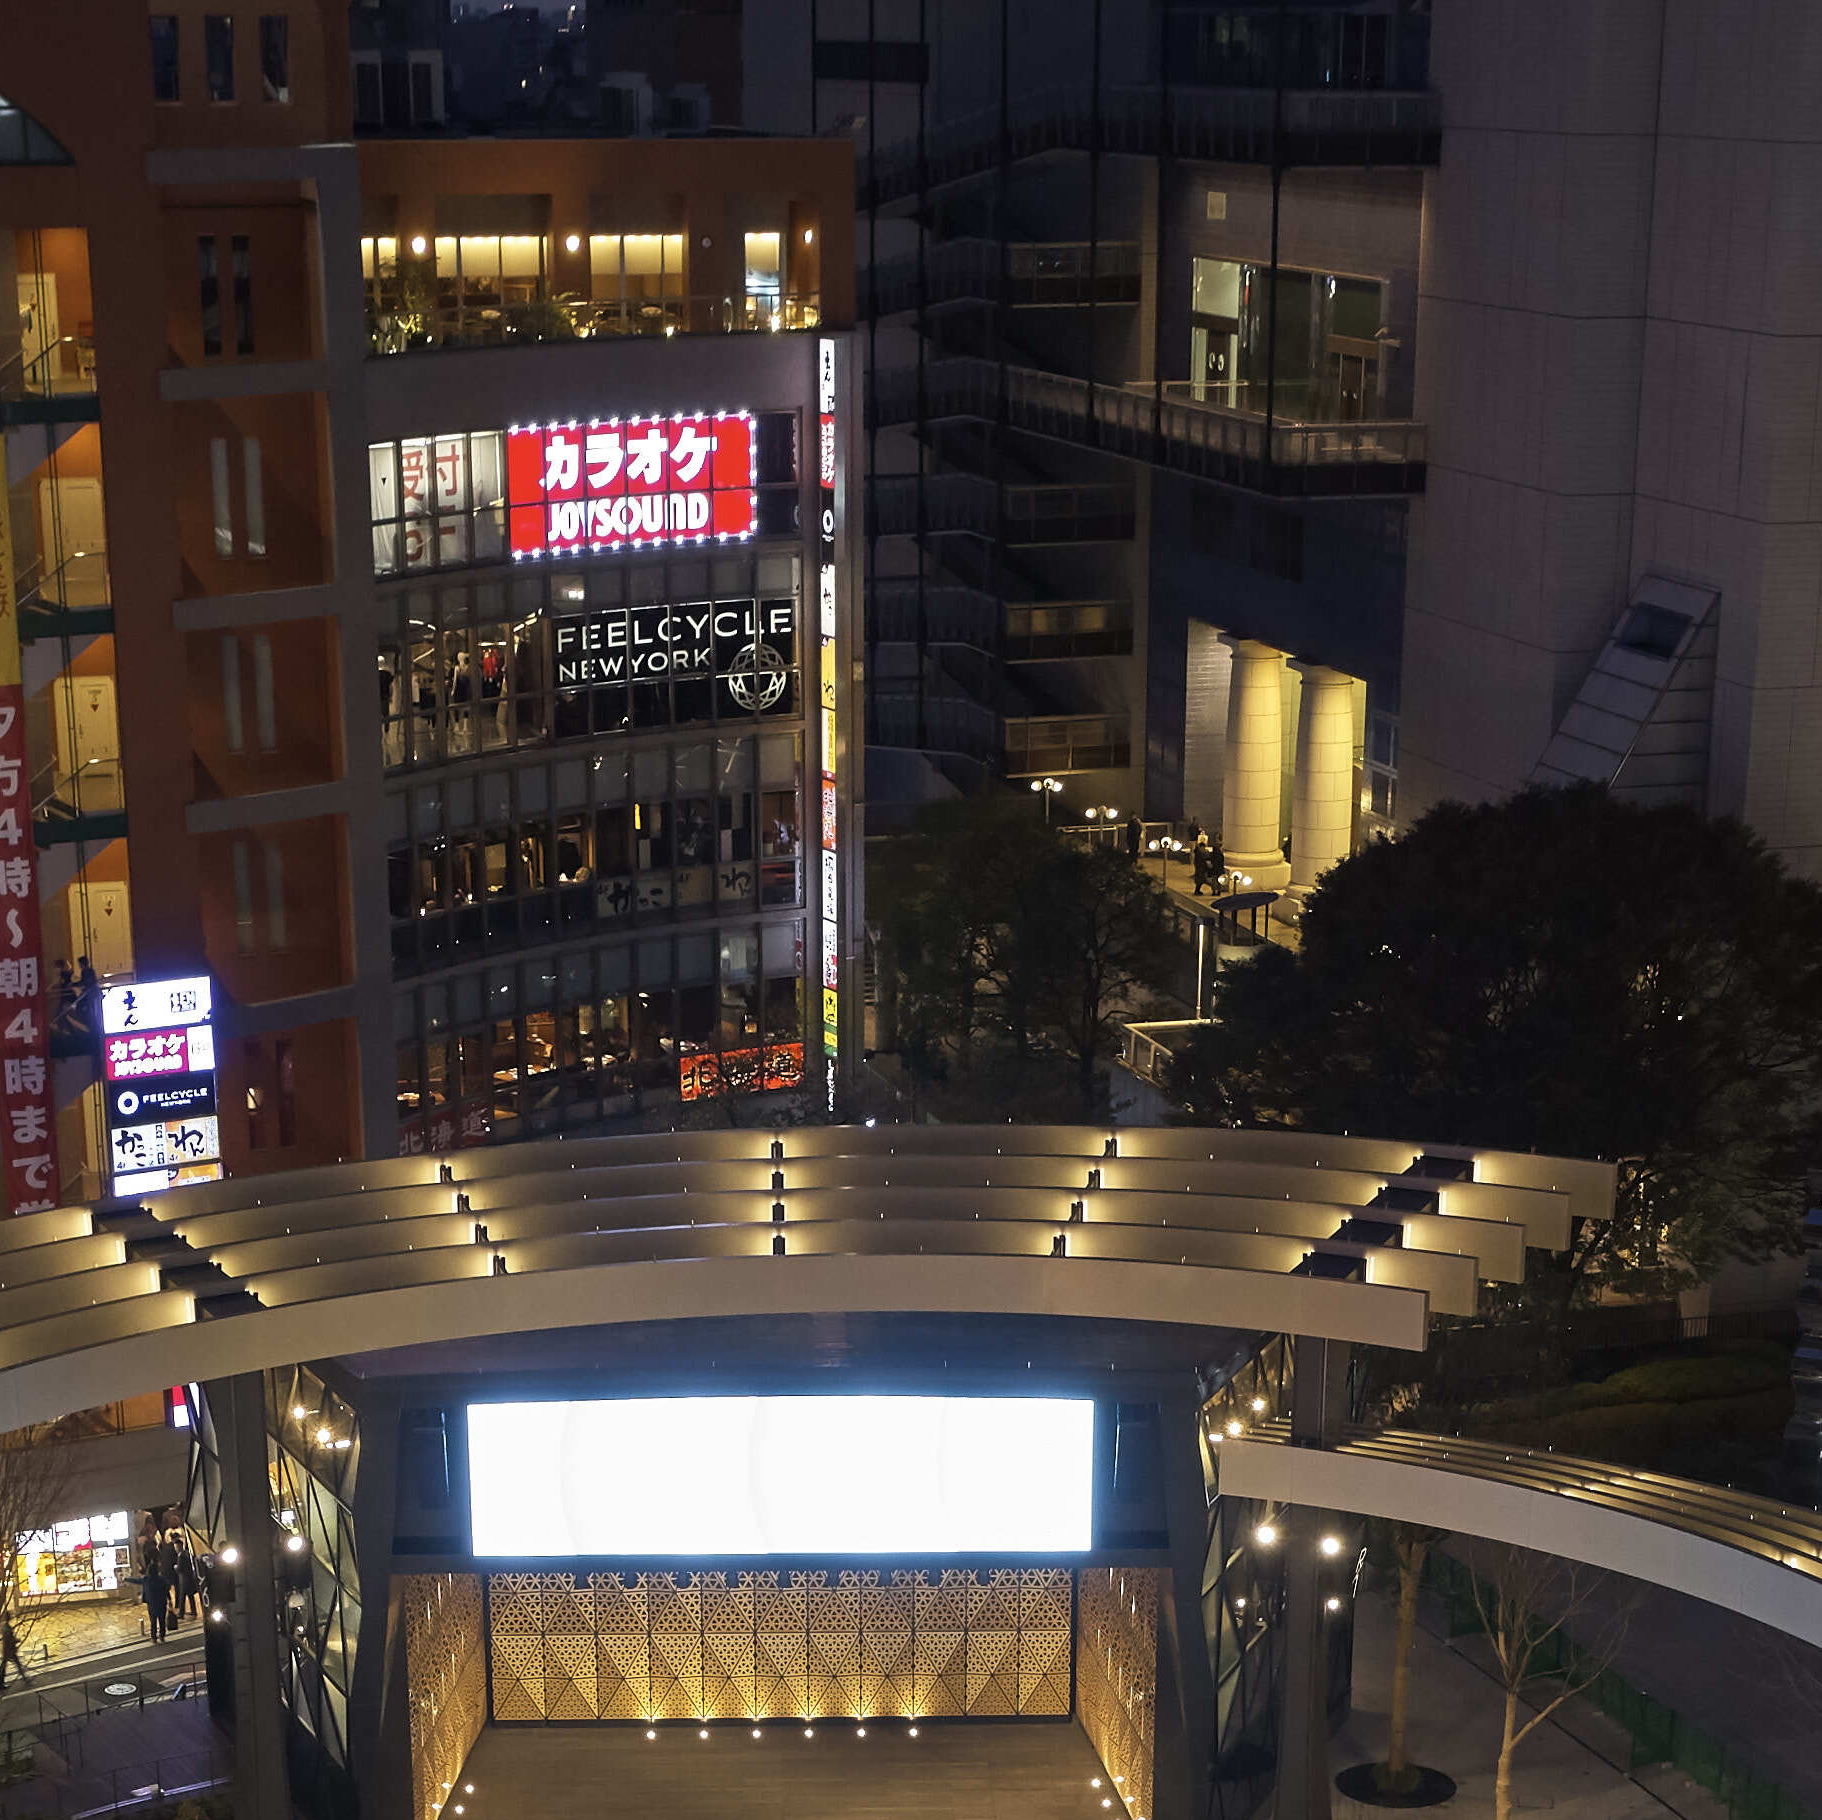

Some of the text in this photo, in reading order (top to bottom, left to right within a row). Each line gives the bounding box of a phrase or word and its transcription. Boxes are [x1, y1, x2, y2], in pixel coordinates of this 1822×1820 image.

[539, 427, 717, 490] カラオケ
[548, 493, 709, 542] JOYSOUND
[558, 608, 792, 654] FEELCYCLE
[559, 647, 712, 683] NEW YORK
[109, 1033, 186, 1063] カラオケ
[142, 1087, 208, 1104] FEELCYCLE
